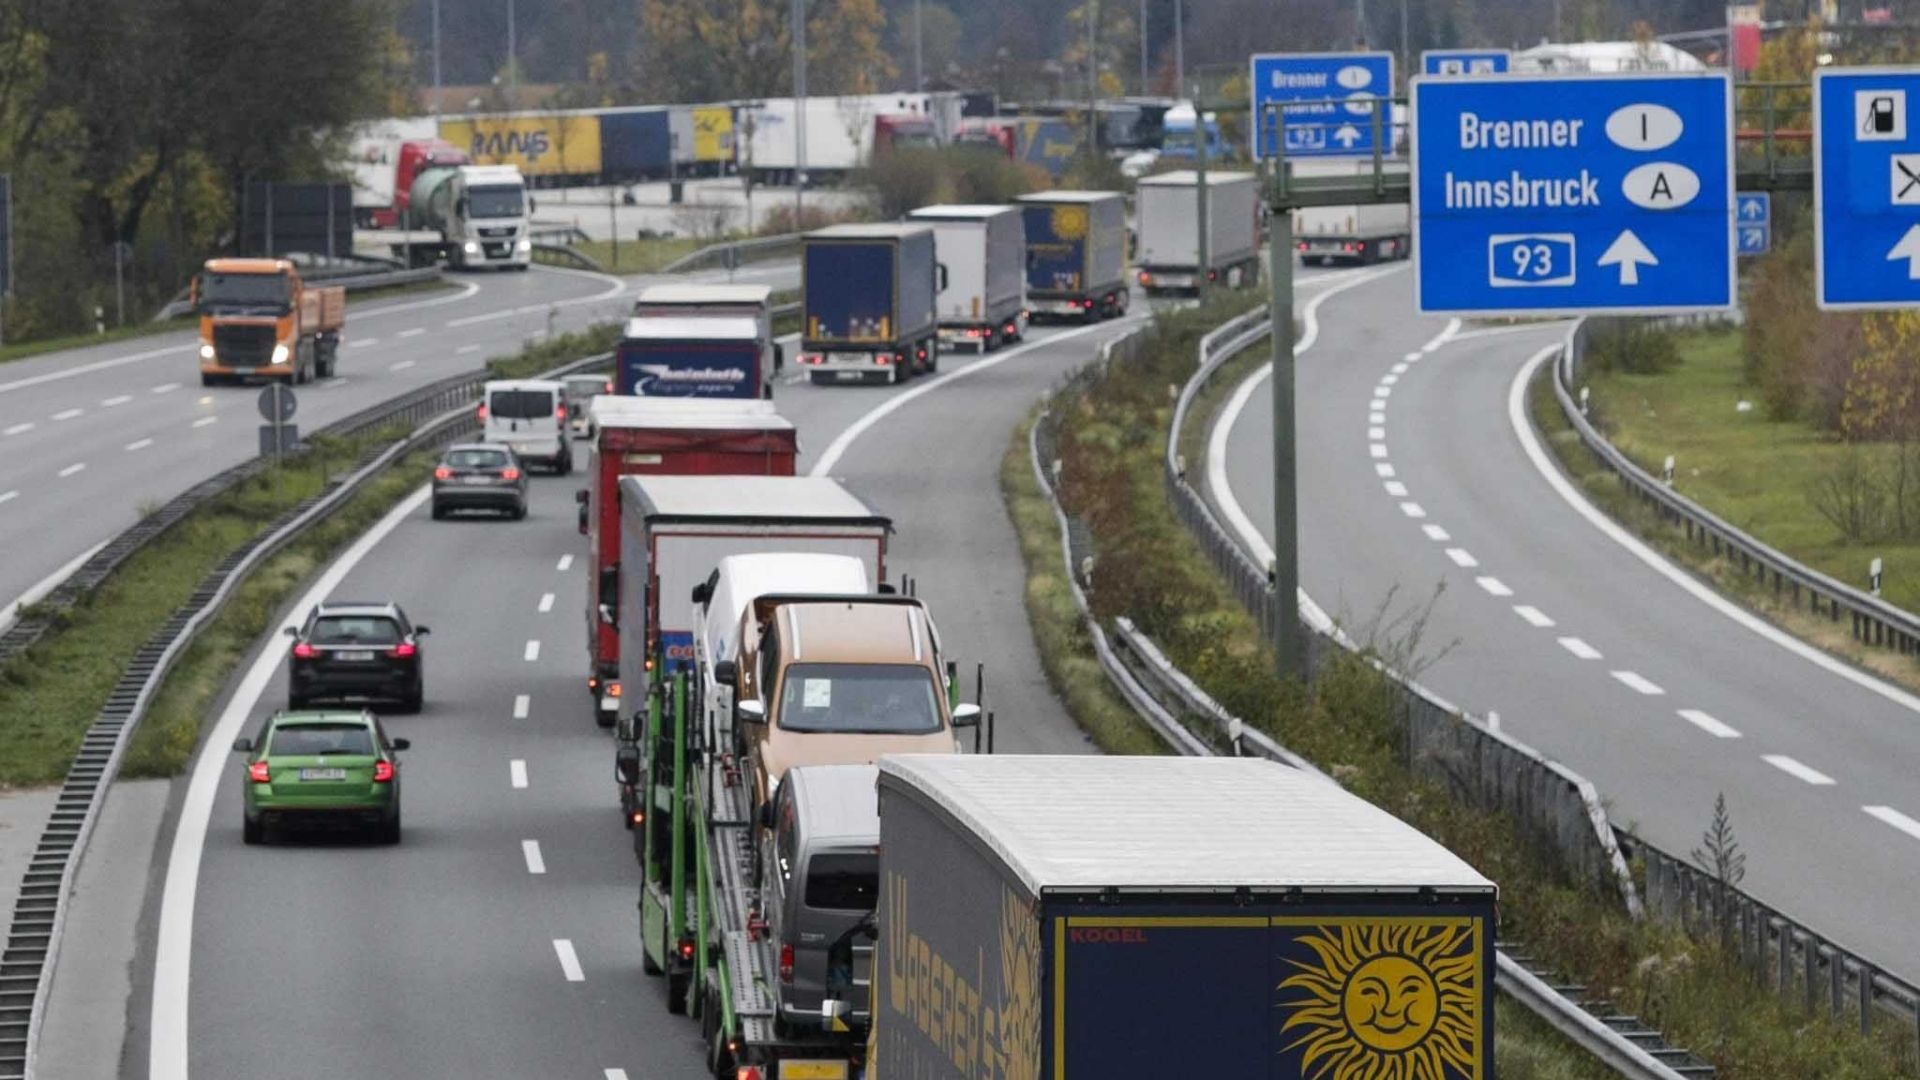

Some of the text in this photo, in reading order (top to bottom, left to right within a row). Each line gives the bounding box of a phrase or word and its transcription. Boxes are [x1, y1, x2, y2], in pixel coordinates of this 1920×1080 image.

[1272, 69, 1328, 88] Brenner
[1460, 112, 1648, 149] Brenner I
[1445, 168, 1674, 209] Innsbruck A
[1512, 244, 1553, 277] 93
